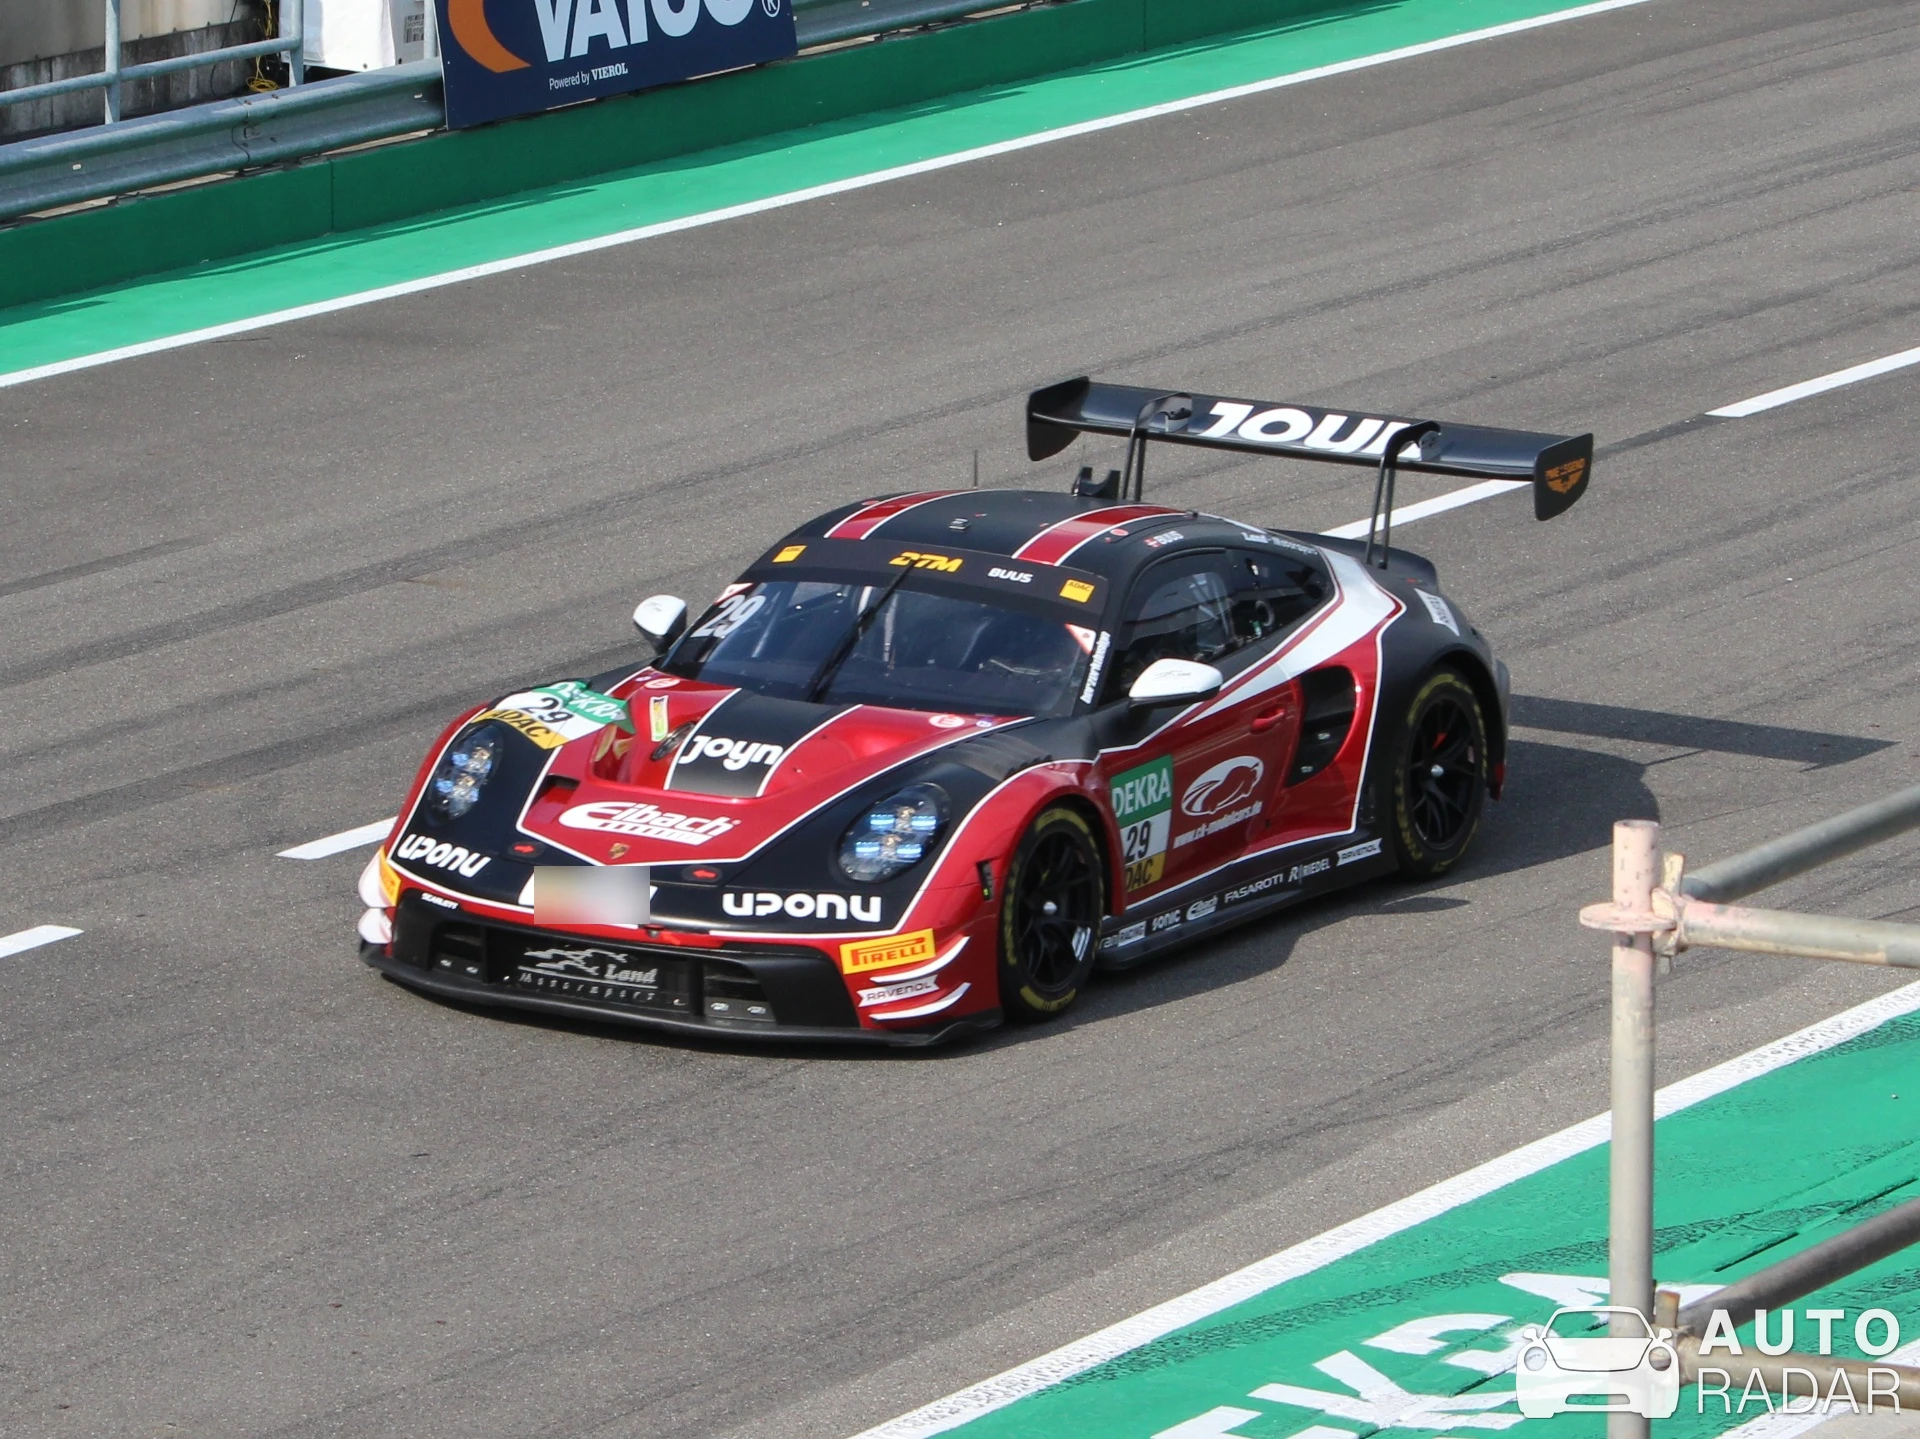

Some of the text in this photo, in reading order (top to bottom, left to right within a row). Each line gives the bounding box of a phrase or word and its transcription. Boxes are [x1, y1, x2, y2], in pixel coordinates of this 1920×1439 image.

[549, 62, 628, 91] Powered by VIEROL
[987, 567, 1034, 584] BUUS
[690, 594, 767, 639] 29
[522, 697, 575, 724] 29
[1112, 767, 1172, 818] DEKRA
[559, 801, 736, 846] Eibach
[1125, 820, 1151, 864] 29
[1225, 874, 1284, 903] FASAROTI
[852, 937, 926, 966] PIRELLI
[604, 964, 659, 984] Land
[866, 981, 932, 1001] RAVENOL
